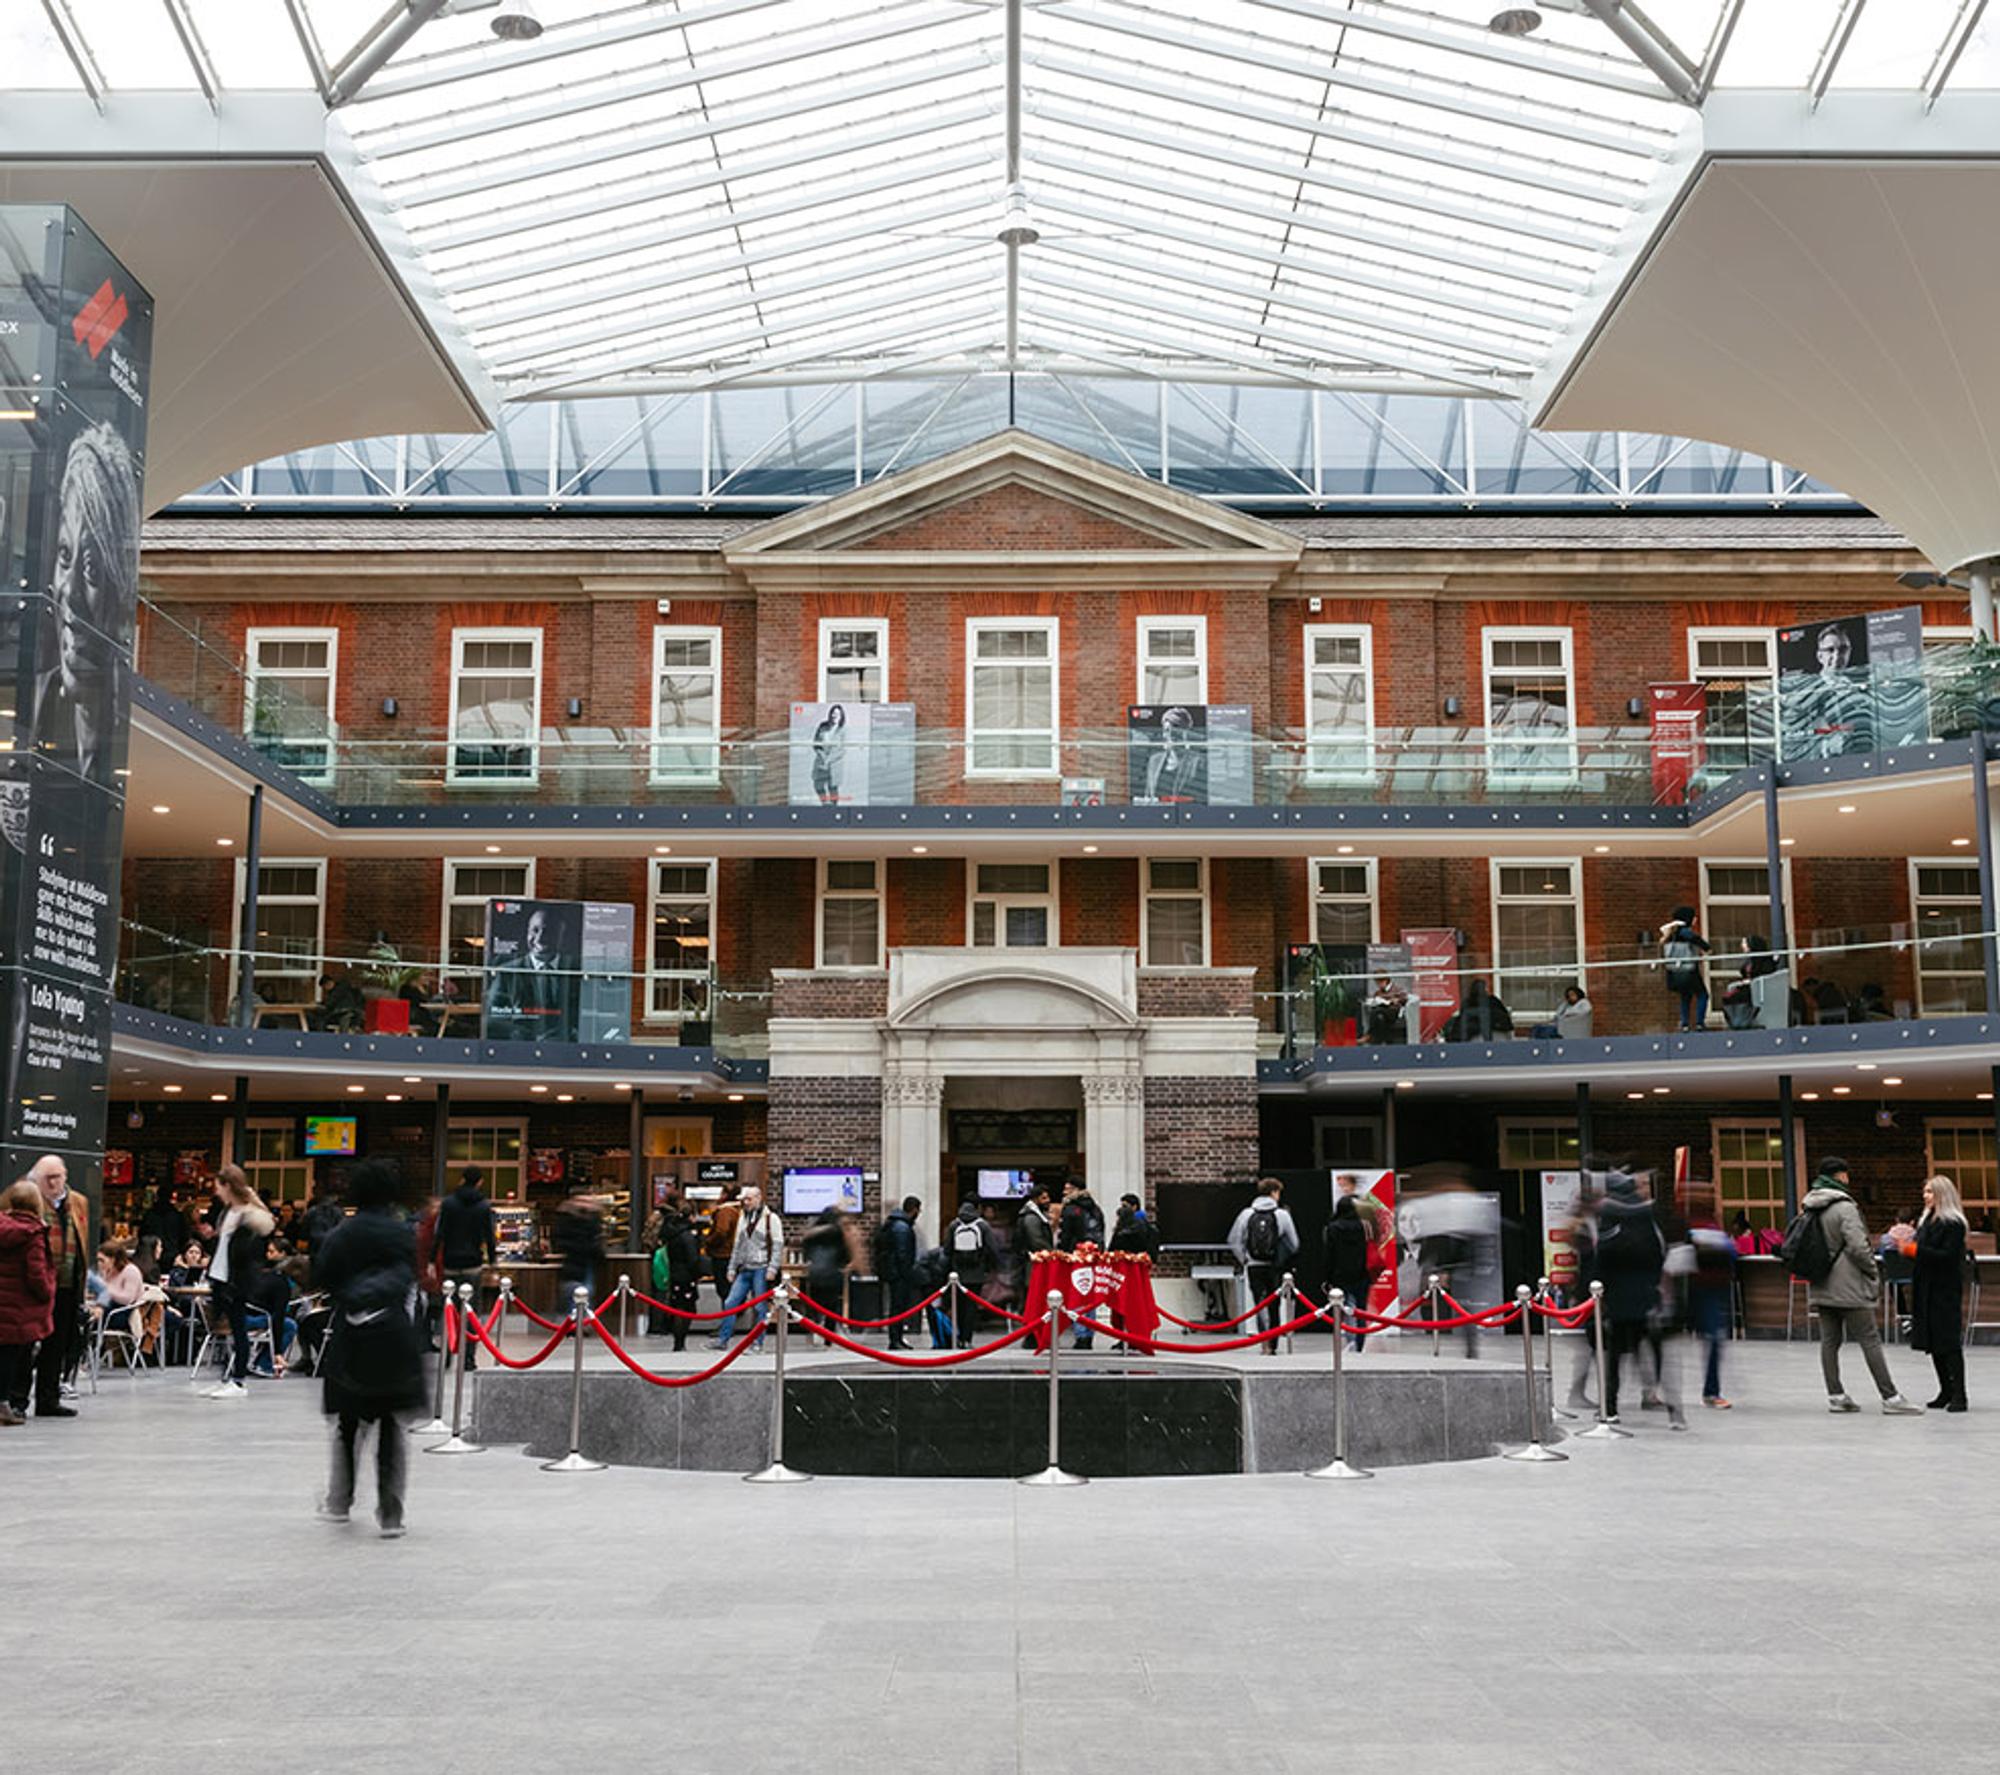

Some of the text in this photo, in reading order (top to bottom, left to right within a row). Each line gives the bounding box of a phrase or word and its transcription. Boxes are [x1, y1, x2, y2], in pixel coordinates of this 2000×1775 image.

[39, 866, 108, 906] Studying at Middlesex
[56, 894, 67, 909] me
[55, 911, 74, 930] which
[35, 926, 48, 941] me
[48, 928, 56, 943] to
[57, 929, 66, 946] do
[67, 934, 82, 952] what
[87, 940, 96, 956] do
[51, 949, 66, 966] with
[31, 984, 84, 1023] Lola Young
